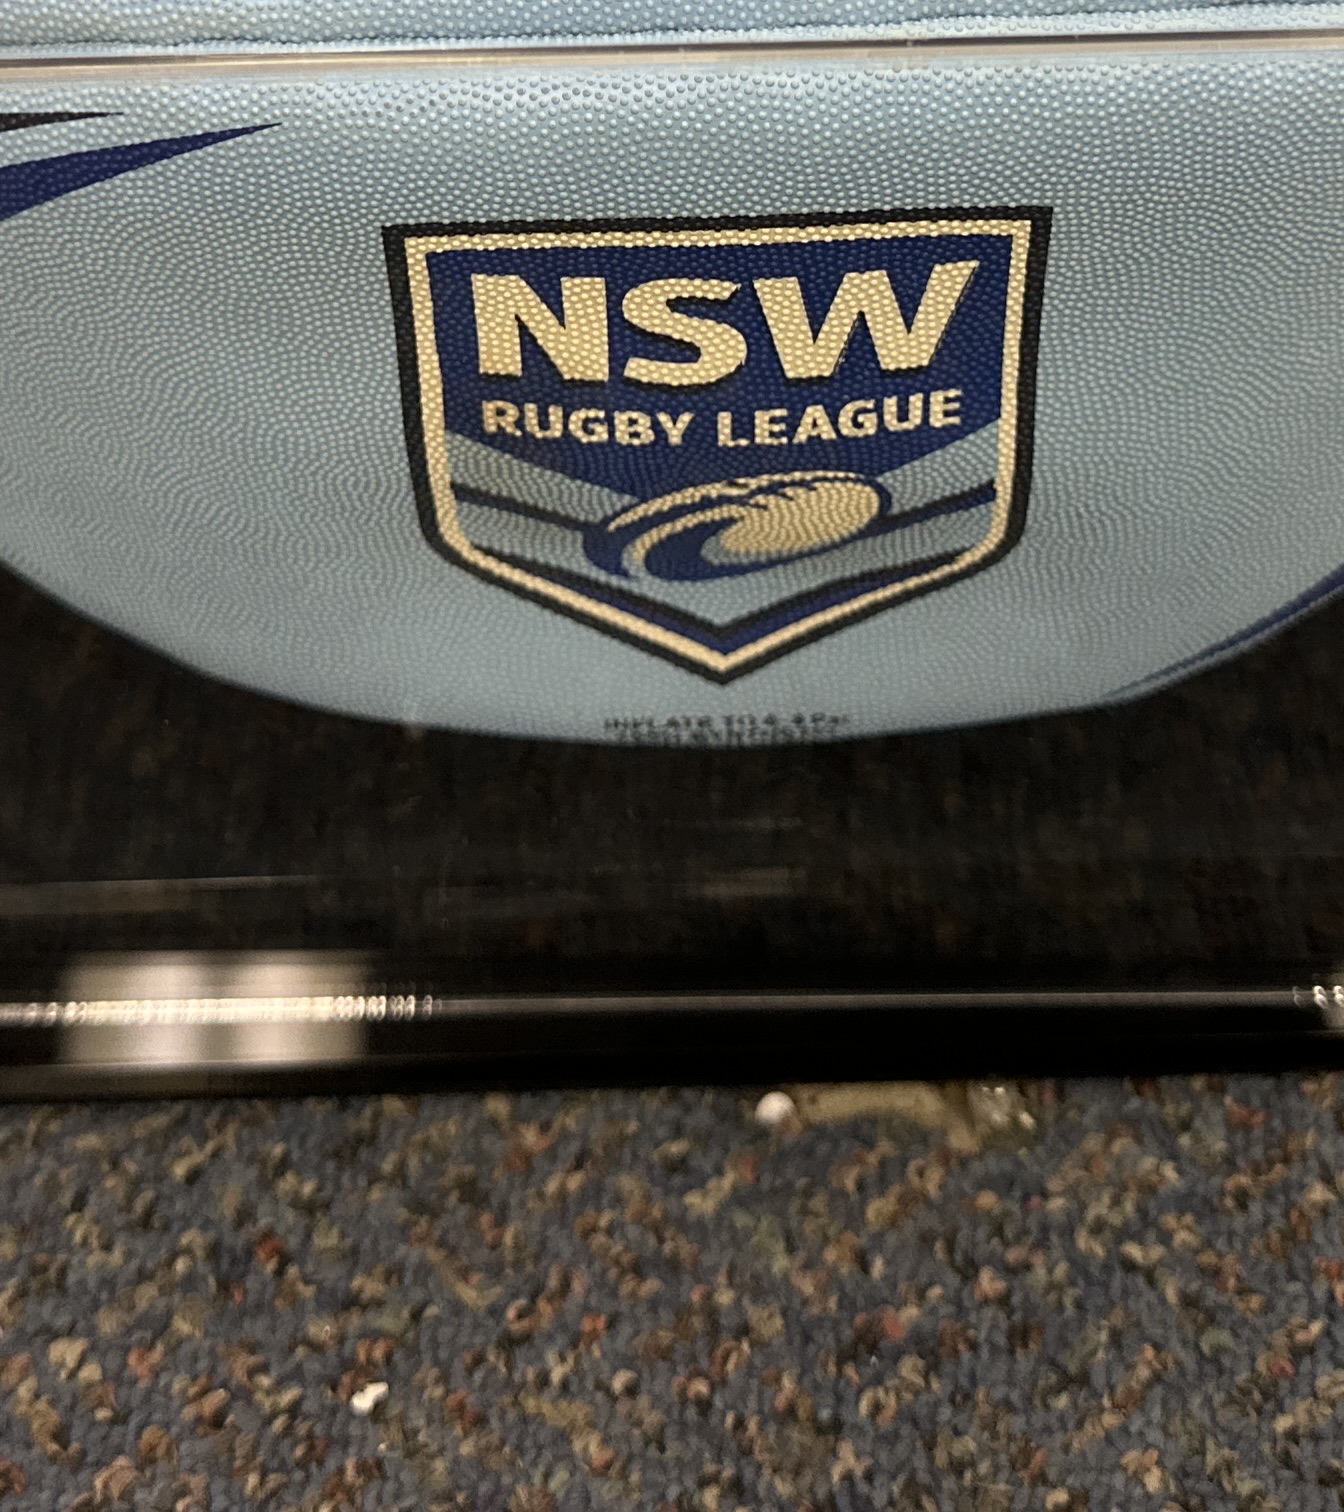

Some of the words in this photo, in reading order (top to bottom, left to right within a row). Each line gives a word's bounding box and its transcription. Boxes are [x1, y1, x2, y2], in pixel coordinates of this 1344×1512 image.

[469, 260, 981, 388] NSW
[482, 399, 692, 448] RUGBY
[717, 389, 963, 448] LEAGUE
